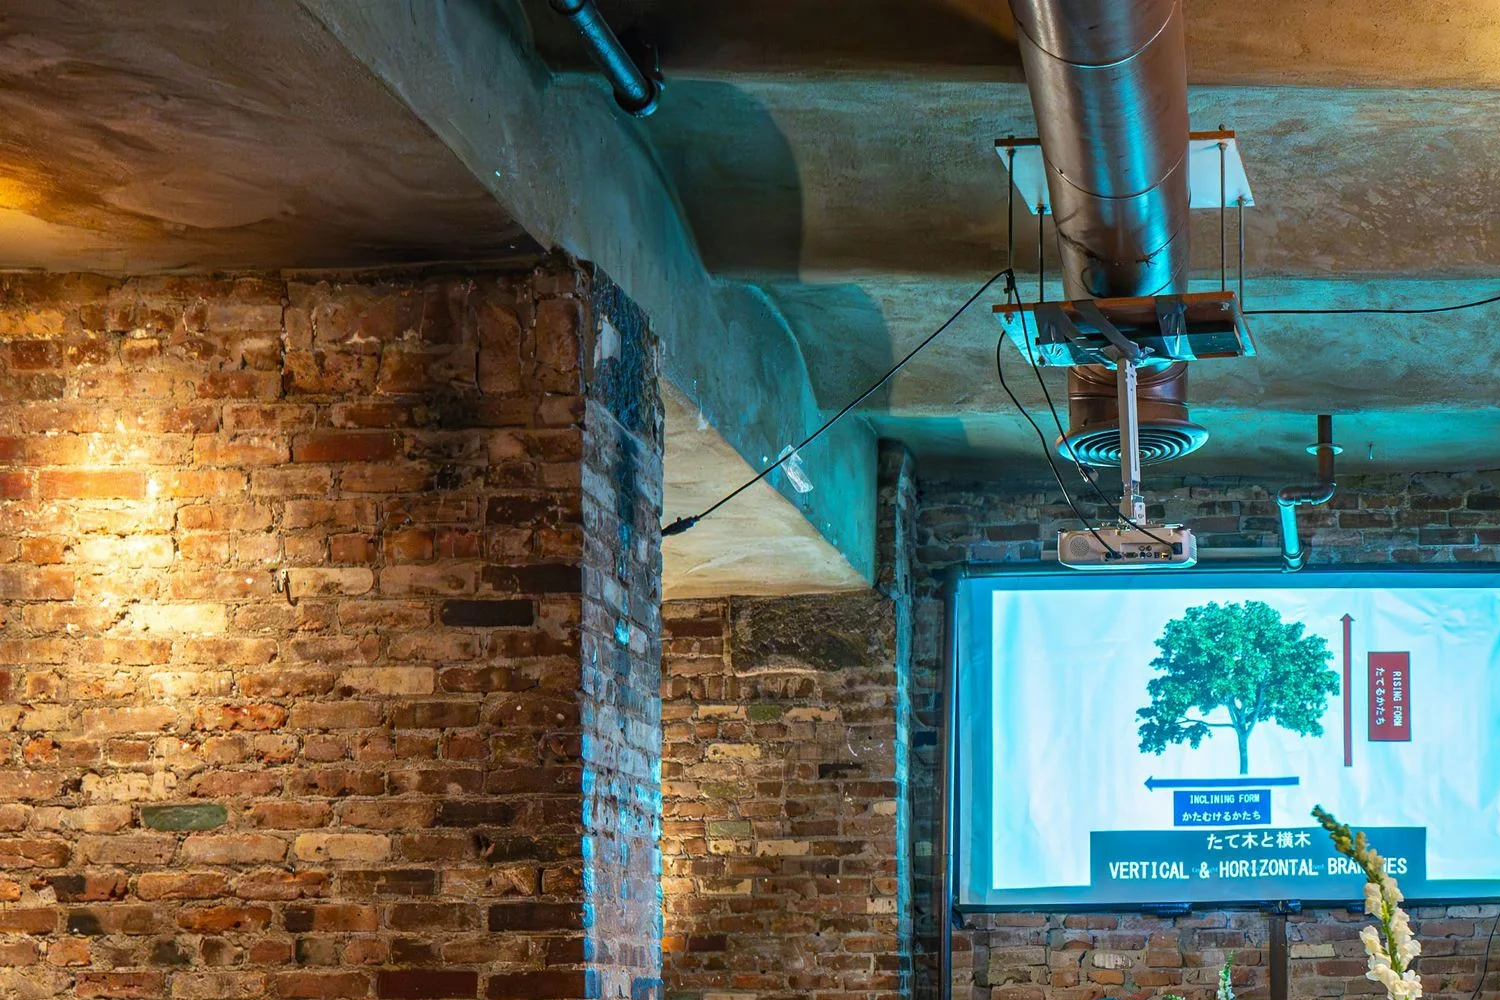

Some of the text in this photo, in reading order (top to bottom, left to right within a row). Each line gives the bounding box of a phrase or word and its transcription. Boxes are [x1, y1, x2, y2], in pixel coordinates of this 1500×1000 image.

[1375, 667, 1385, 726] たてるかたち
[1393, 671, 1402, 727] RISING FORM
[1190, 793, 1260, 805] INCLINING FORM
[1182, 810, 1261, 822] かたむけるかたち
[1207, 831, 1311, 850] たて木と横木
[1109, 861, 1190, 880] VERTICAL
[1199, 861, 1210, 879] &
[1219, 858, 1319, 878] HORIZONTAL
[1328, 857, 1408, 875] BRAES
